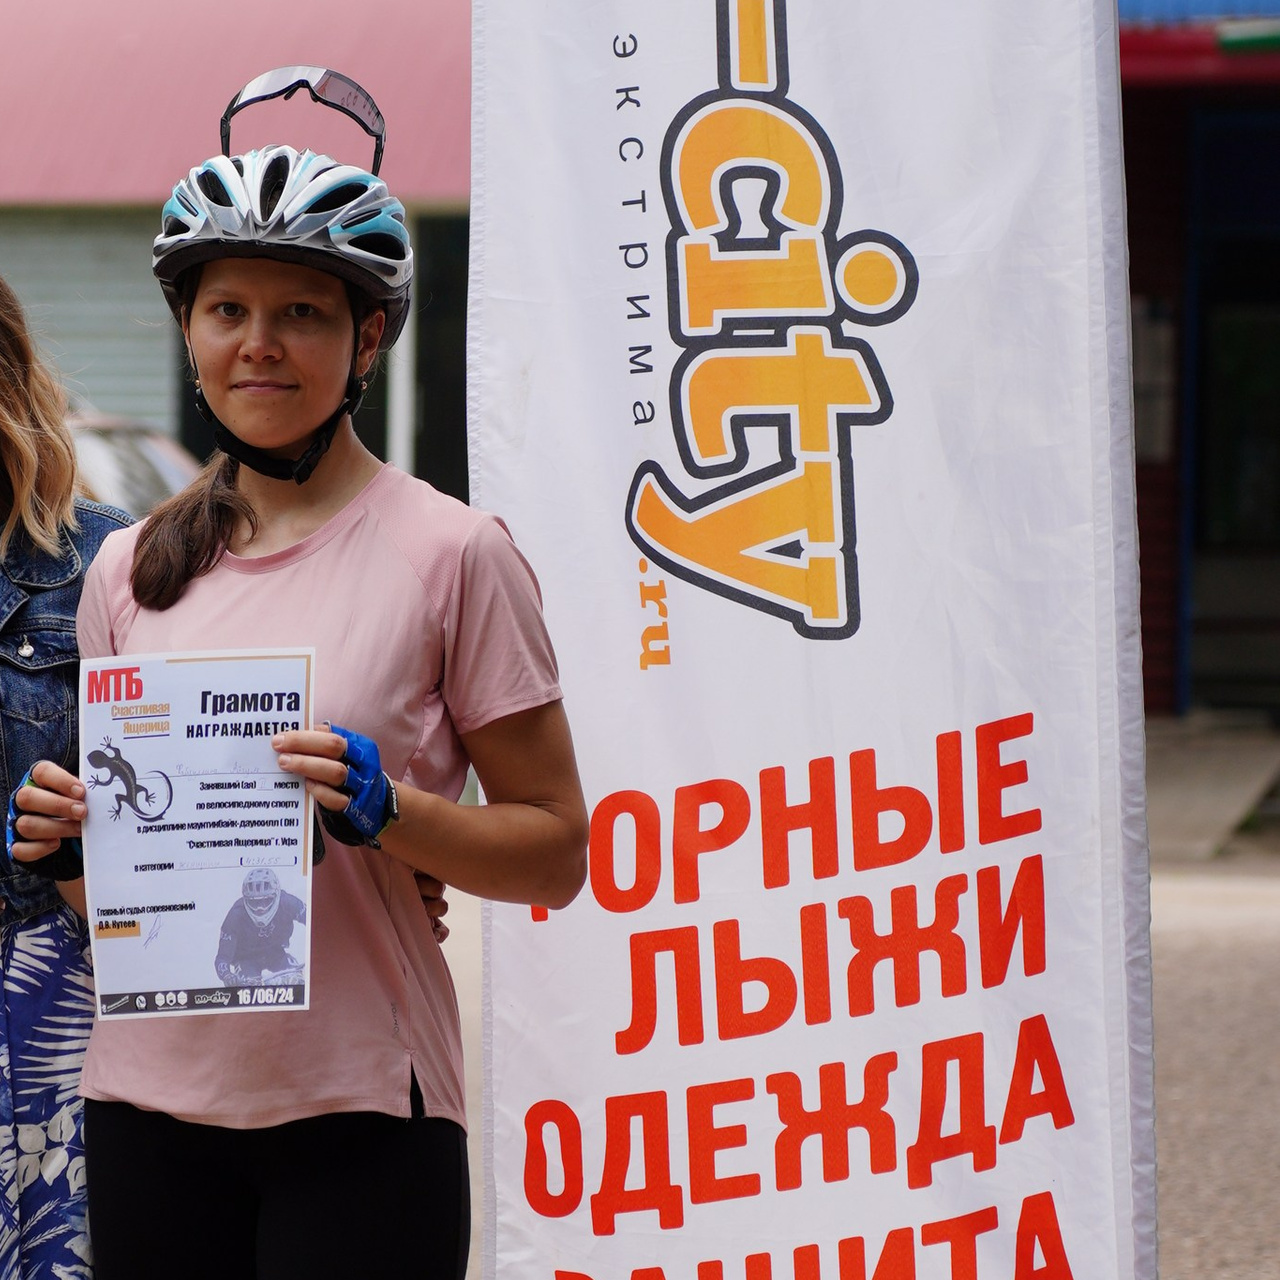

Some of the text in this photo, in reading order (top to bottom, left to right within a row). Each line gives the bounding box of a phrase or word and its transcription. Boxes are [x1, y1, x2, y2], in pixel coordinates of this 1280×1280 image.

[612, 33, 656, 425] экстрима
[639, 557, 671, 670] .ru
[87, 666, 143, 704] МТБ
[111, 702, 170, 718] Счастливая
[200, 691, 300, 717] Грамота
[123, 720, 170, 735] Ящерица
[186, 721, 299, 739] НАГРАЖДАЕТСЯ
[199, 779, 240, 791] Занявший
[274, 781, 300, 790] место
[196, 800, 299, 811] по велосипедному спорту
[531, 712, 1044, 921] ОРНЫЕ
[137, 826, 142, 834] в
[142, 823, 186, 835] дисциплине
[281, 838, 298, 848] Уфа
[139, 862, 175, 872] категории
[97, 901, 195, 916] Главный судья соревнований
[615, 854, 1046, 1055] ЛЫЖИ
[523, 1013, 1076, 1236] ОДЕЖДА
